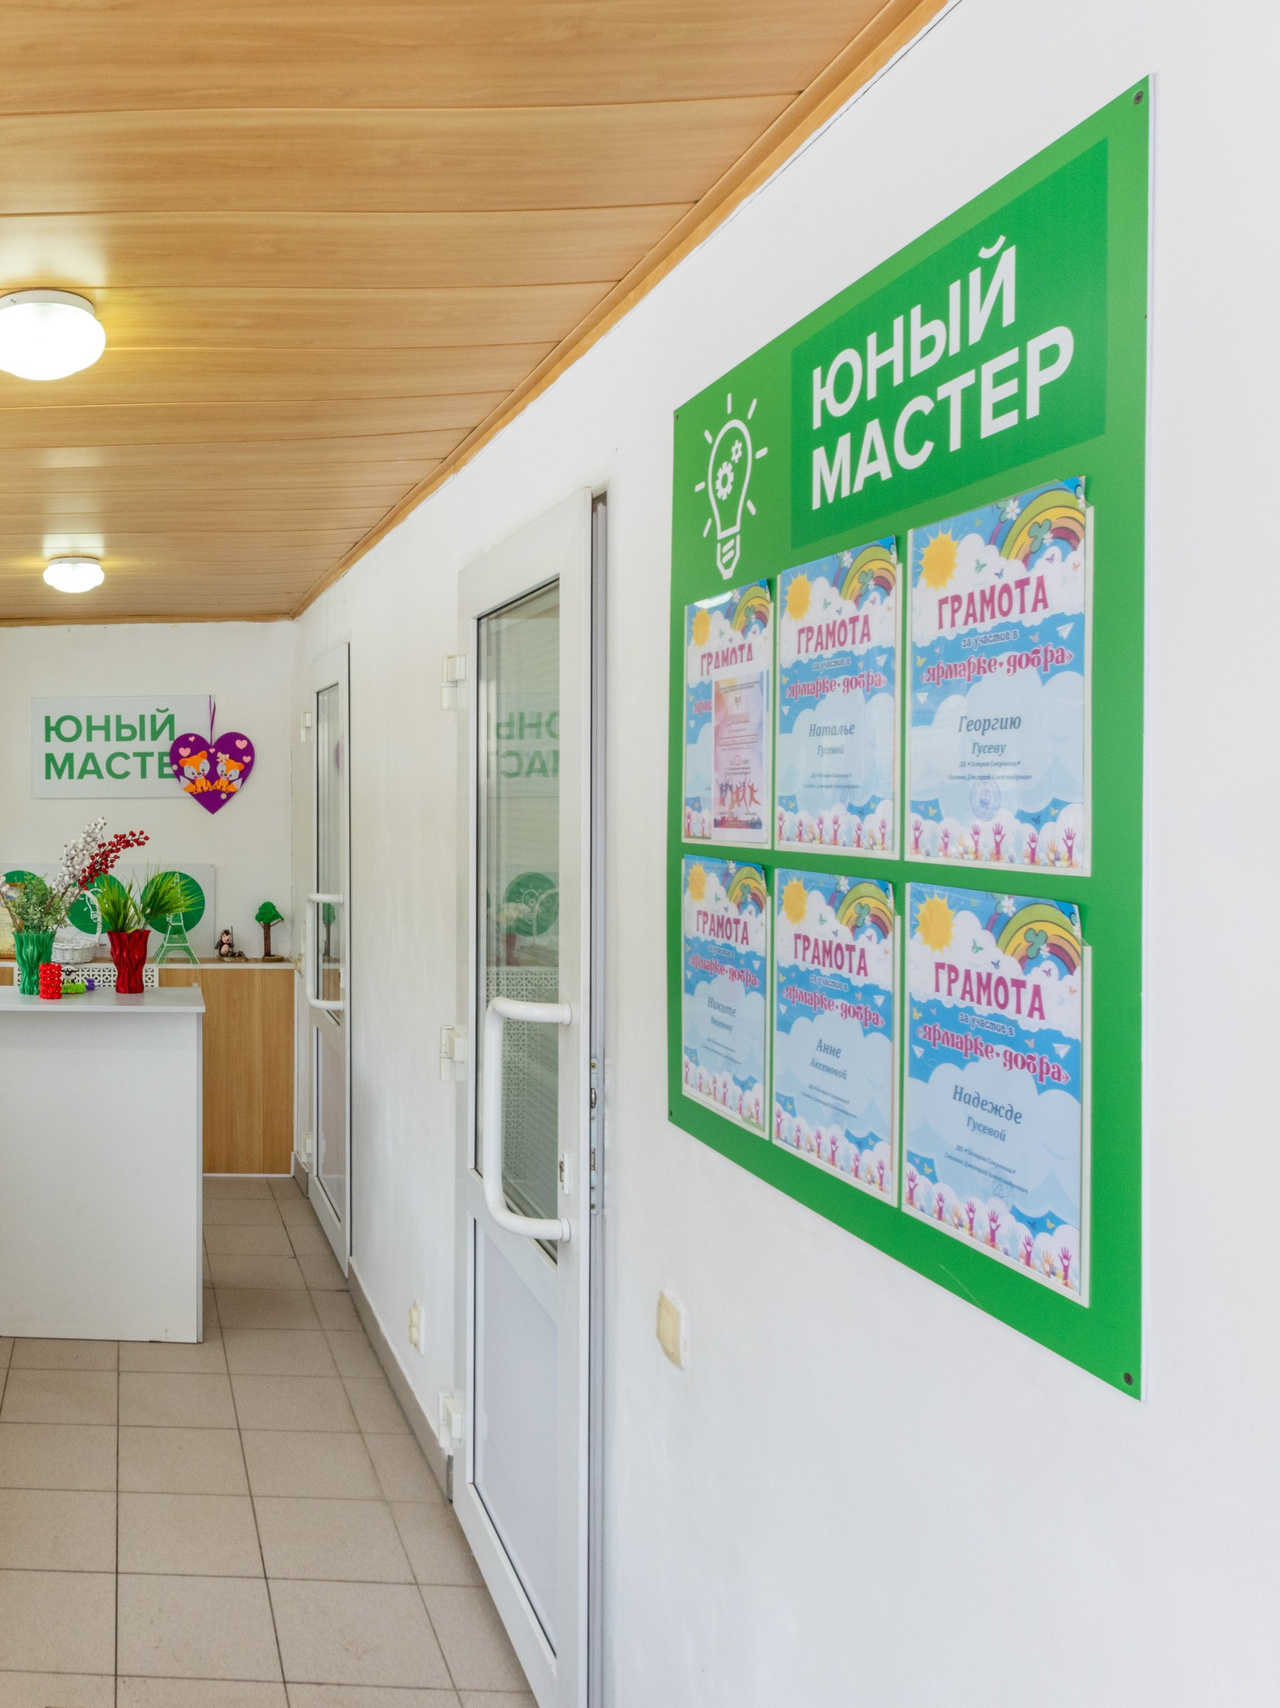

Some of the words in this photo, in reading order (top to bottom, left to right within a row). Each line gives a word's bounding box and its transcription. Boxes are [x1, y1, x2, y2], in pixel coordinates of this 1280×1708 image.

[812, 235, 1017, 430] ЮНЫЙ
[812, 326, 1075, 511] МАСТЕР
[938, 575, 1049, 630] ГРАМОТА
[797, 614, 871, 655] ГРАМОТА
[973, 632, 1010, 650] участие
[700, 642, 753, 676] ГРАМОТА
[44, 707, 175, 743] ЮНЫЙ
[809, 723, 855, 737] Наталье
[958, 715, 1021, 736] Георгию
[45, 751, 177, 780] МАСТЕ
[817, 744, 845, 757] Гусевой
[971, 742, 1006, 757] Гусеву
[696, 910, 749, 945] ГРАМОТА
[794, 933, 868, 977] ГРАМОТА
[934, 962, 1046, 1020] ГРАМОТА
[971, 1016, 1007, 1034] участие
[816, 1039, 841, 1059] Анне
[952, 1084, 1022, 1125] Надежде
[967, 1116, 1007, 1142] Гусевой
